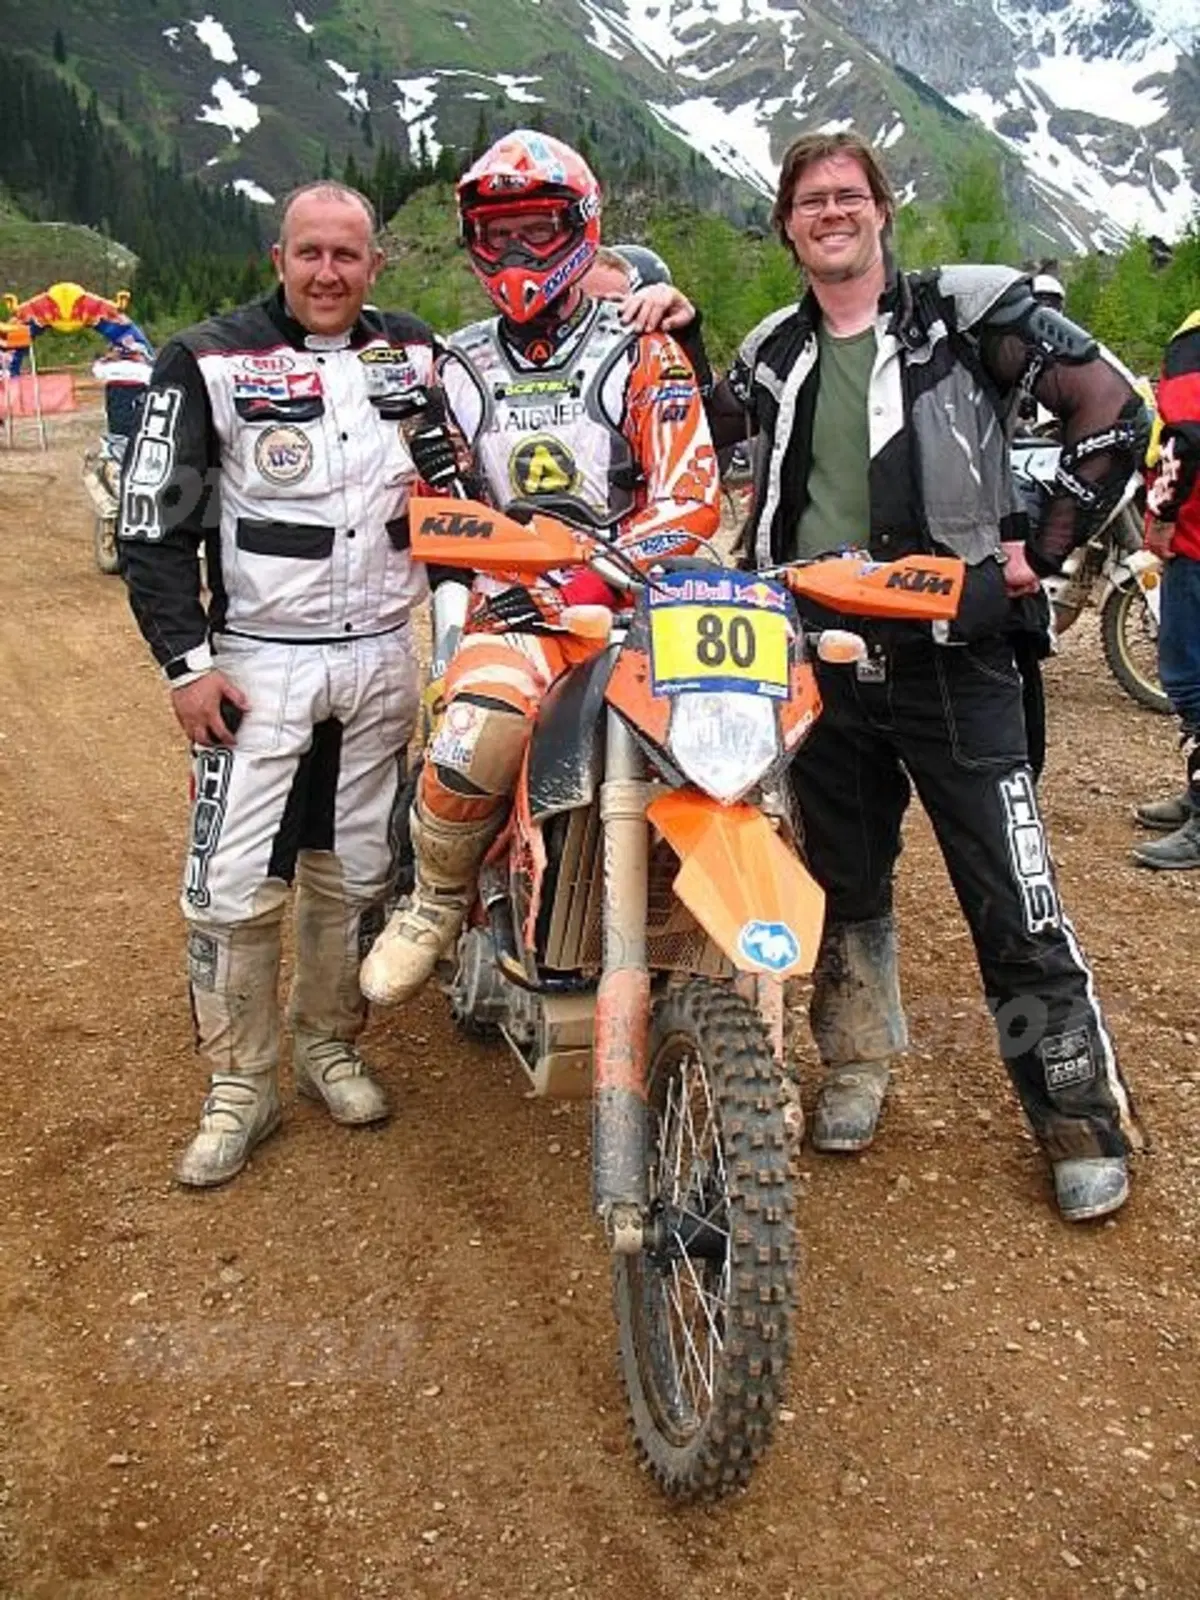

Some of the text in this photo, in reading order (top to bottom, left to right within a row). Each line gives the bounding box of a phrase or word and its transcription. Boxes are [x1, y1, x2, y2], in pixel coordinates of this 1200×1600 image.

[420, 512, 495, 538] KTM
[885, 567, 955, 595] KTM
[697, 613, 756, 668] 80
